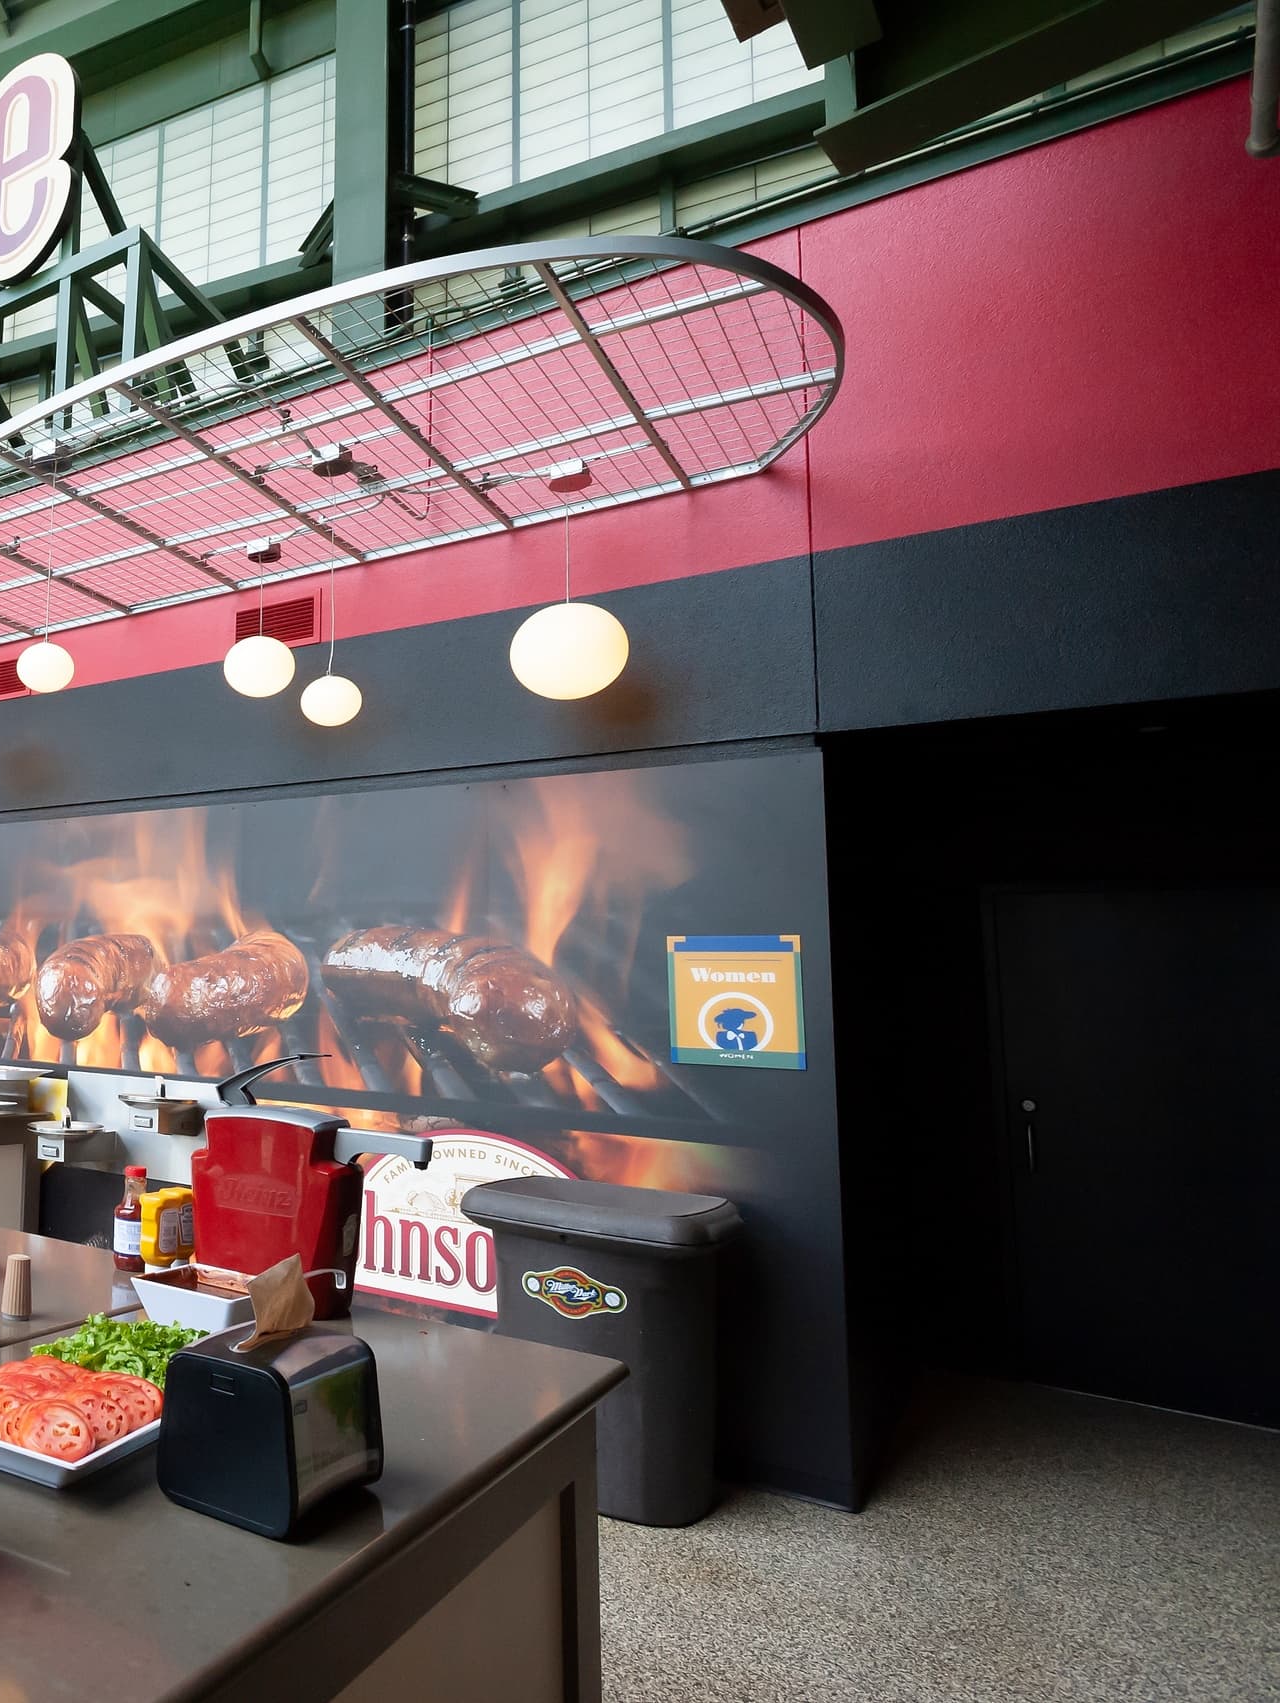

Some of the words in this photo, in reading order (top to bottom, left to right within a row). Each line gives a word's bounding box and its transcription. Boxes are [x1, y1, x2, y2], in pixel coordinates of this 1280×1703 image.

[690, 967, 777, 984] Women
[383, 1161, 413, 1184] FAMI
[433, 1148, 487, 1160] OWNED
[363, 1189, 497, 1293] hnso
